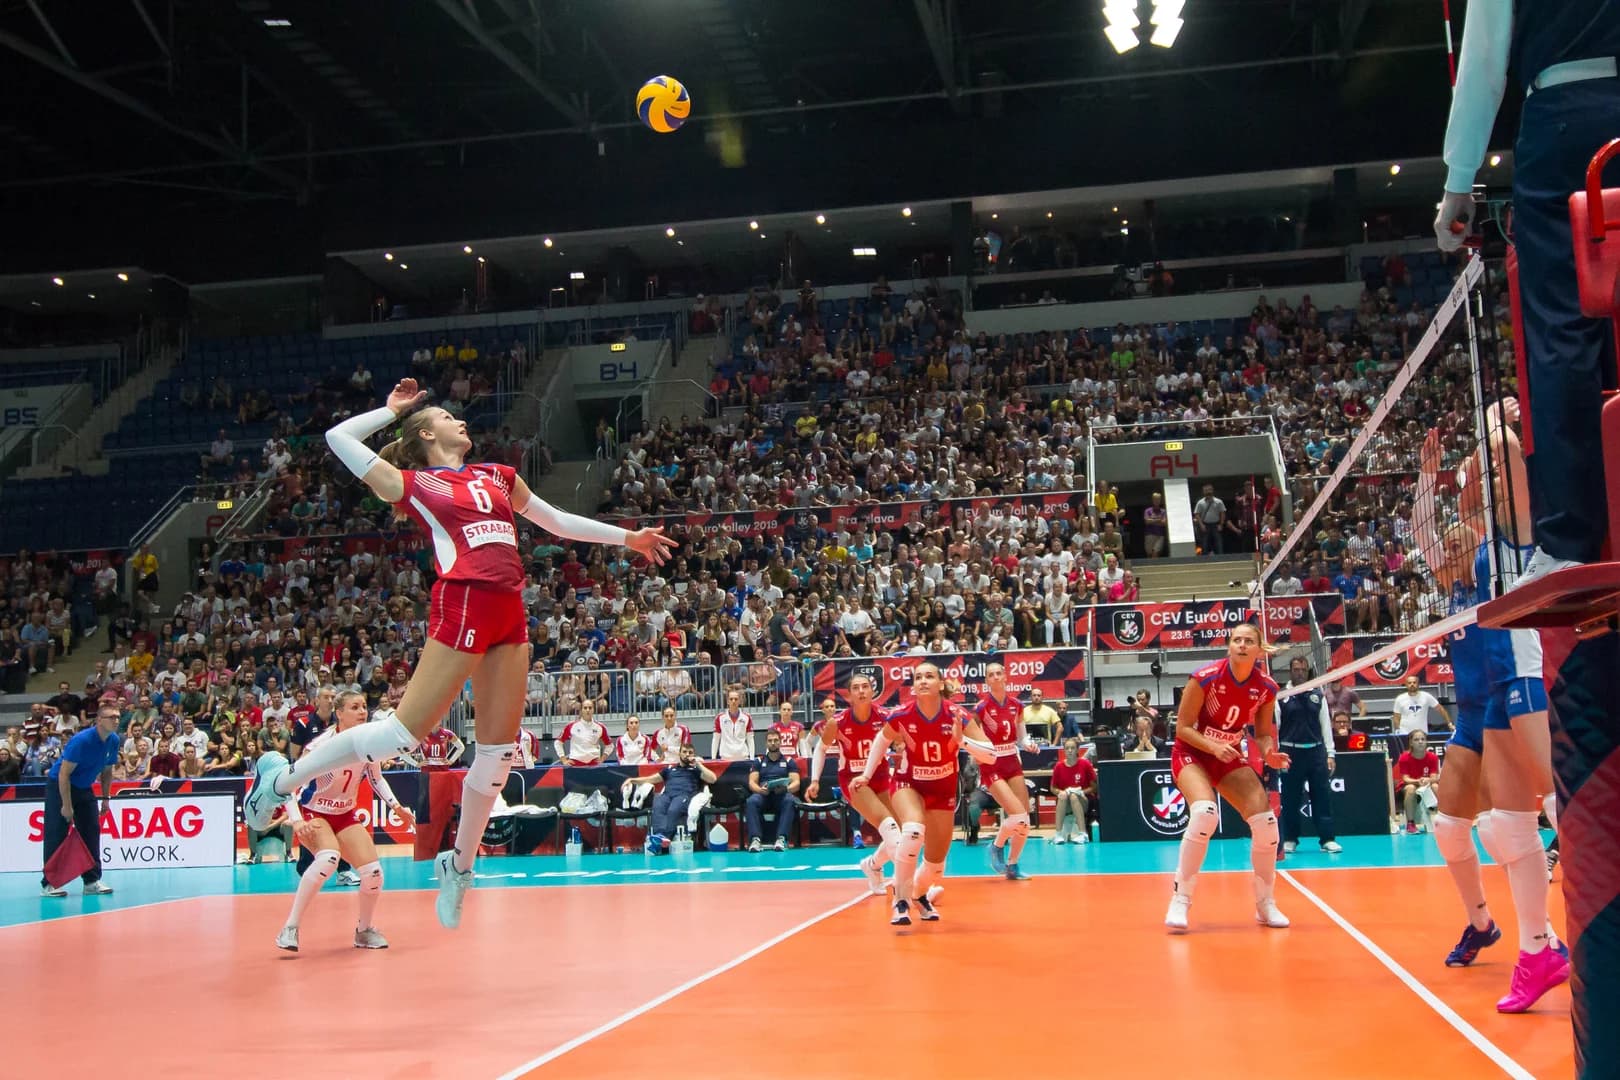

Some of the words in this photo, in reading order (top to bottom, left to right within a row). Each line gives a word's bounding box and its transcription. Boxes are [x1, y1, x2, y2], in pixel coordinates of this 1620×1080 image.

[600, 362, 637, 380] B4
[1151, 453, 1199, 477] A4
[467, 480, 493, 513] 6
[465, 523, 514, 539] STRABAG
[753, 520, 778, 531] 2019
[1150, 611, 1182, 626] CEV
[1185, 607, 1246, 624] EuroVoll
[1269, 606, 1303, 620] 2019
[464, 629, 476, 648] 6
[1009, 661, 1045, 676] 2019
[1222, 705, 1240, 730] 9
[780, 732, 793, 746] 22
[431, 743, 441, 757] 10
[858, 739, 874, 759] 12
[922, 741, 942, 762] 13
[343, 769, 353, 793] 7
[1155, 775, 1172, 784] CE
[28, 805, 204, 842] SABAG
[120, 845, 185, 862] WORK.
